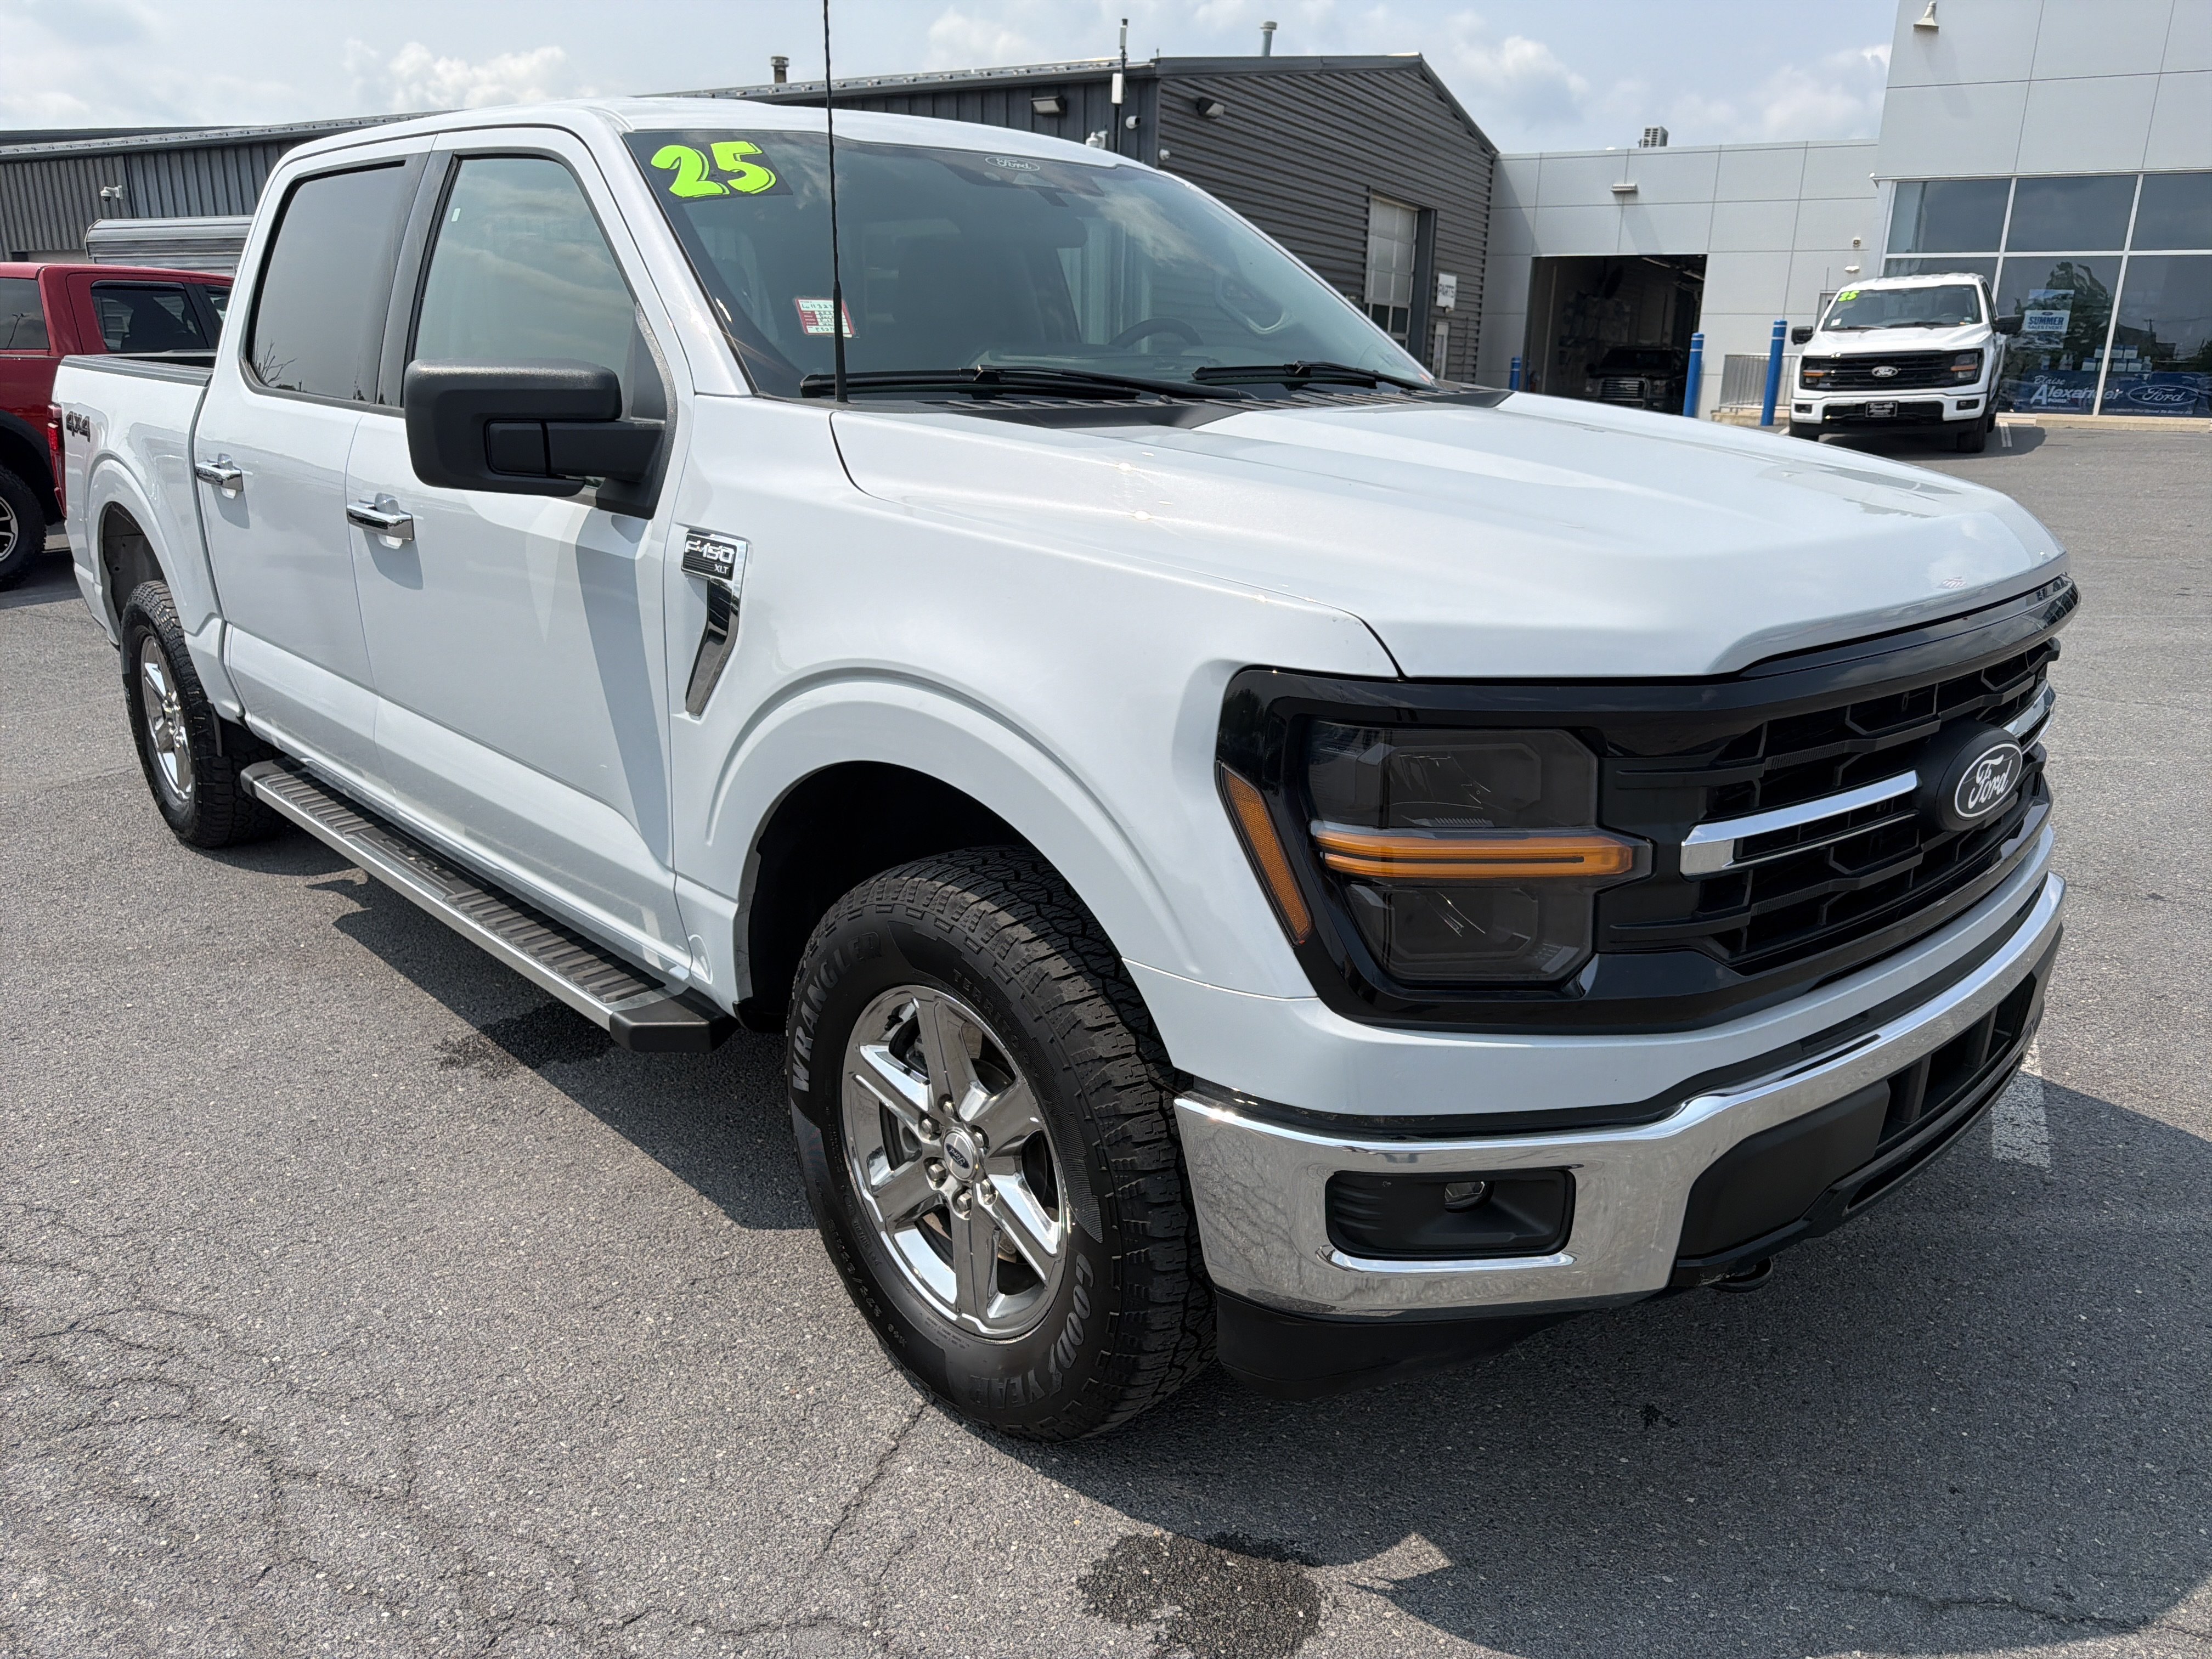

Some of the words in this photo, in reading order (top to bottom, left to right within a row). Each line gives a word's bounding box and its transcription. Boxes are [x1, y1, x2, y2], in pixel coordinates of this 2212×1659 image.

[651, 140, 776, 198] 25
[996, 157, 1032, 170] Ford
[1438, 283, 1454, 298] PARTS
[1838, 290, 1859, 302] 25
[2028, 317, 2064, 325] SUMMER
[2030, 384, 2124, 405] Alexaner
[2142, 387, 2186, 402] Ford
[685, 540, 735, 564] F-150
[714, 564, 729, 574] XLT
[1968, 754, 2013, 809] Ford
[793, 932, 882, 1092] WRANGLER
[969, 1253, 1094, 1409] GOODYEAR
